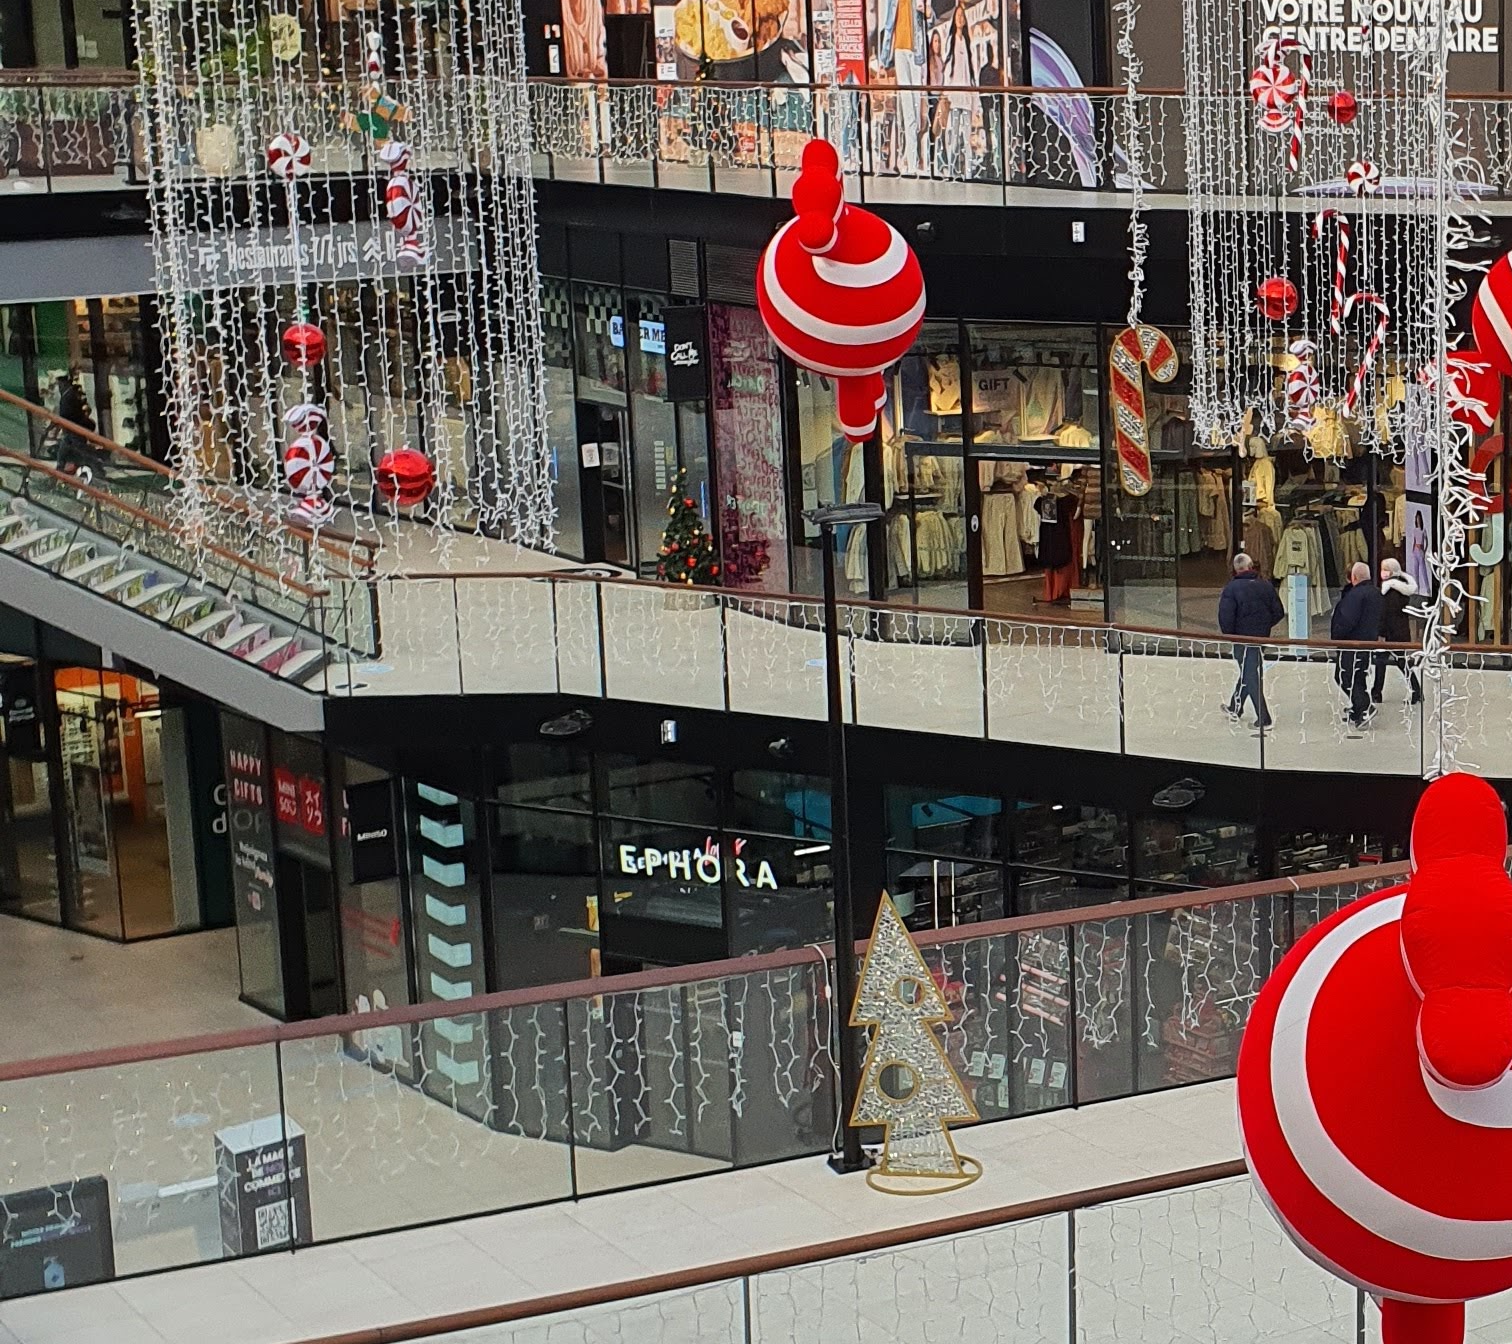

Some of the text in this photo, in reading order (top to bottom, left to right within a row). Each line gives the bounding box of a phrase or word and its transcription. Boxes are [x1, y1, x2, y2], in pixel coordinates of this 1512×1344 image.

[1262, 26, 1499, 53] CENTRE DENTAIRE
[979, 377, 1010, 391] GIFT
[229, 749, 262, 777] HAPPY
[233, 777, 263, 805] GIFTS
